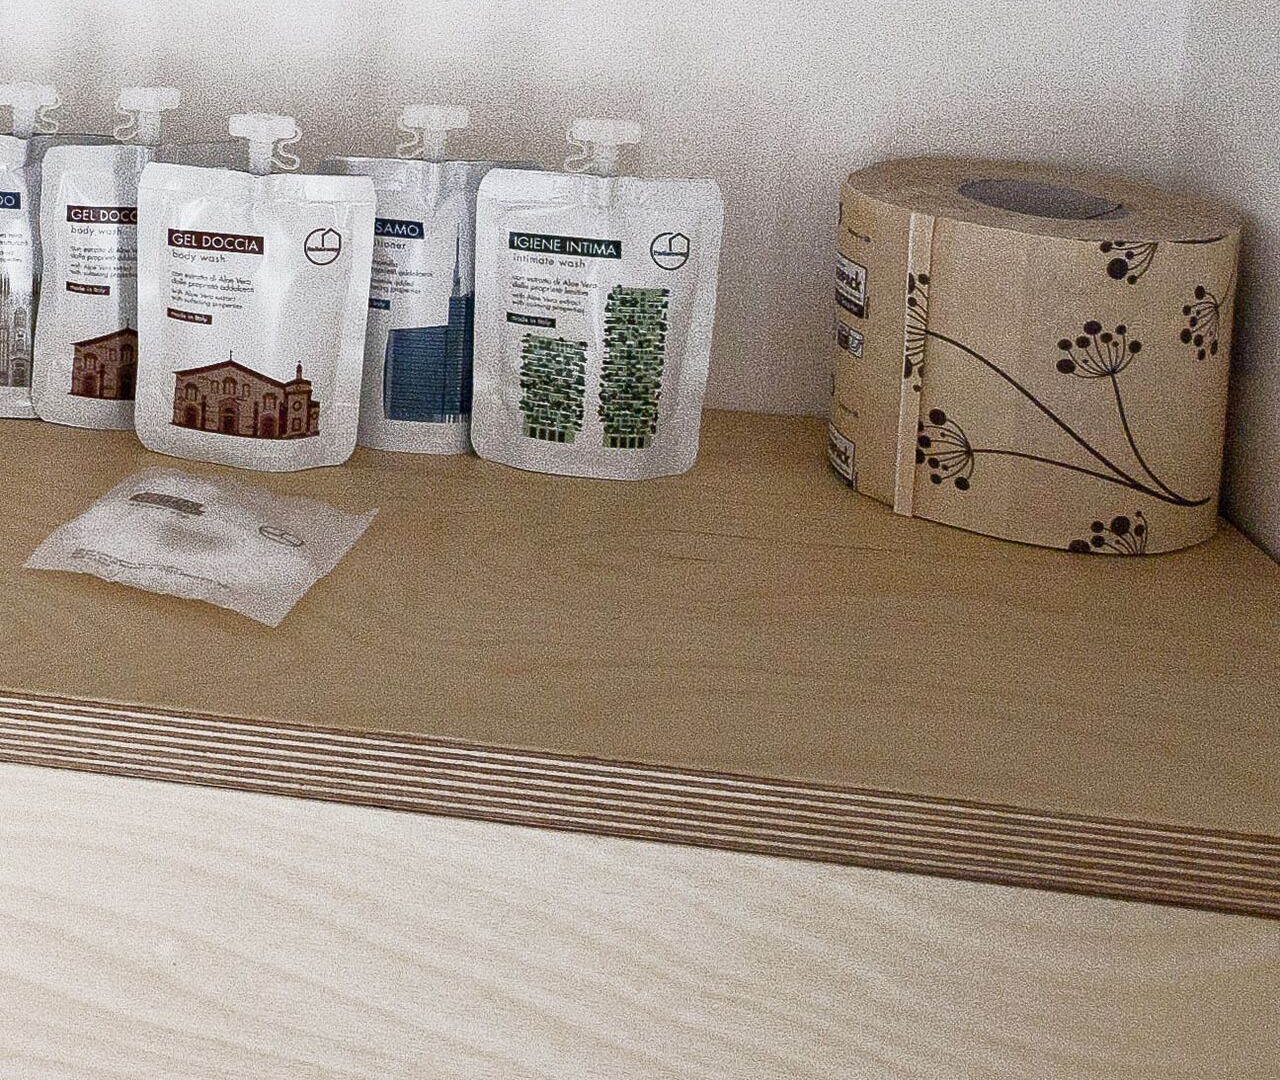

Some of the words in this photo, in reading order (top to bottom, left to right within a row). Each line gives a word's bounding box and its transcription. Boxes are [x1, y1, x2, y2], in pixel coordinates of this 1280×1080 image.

[71, 209, 97, 221] GEL
[70, 225, 95, 237] body
[172, 233, 197, 246] GEL
[202, 236, 259, 251] DOCCIA
[514, 236, 561, 251] IGIENE
[566, 239, 617, 256] INTIMA
[172, 249, 196, 262] body
[200, 254, 226, 263] wash
[513, 253, 555, 266] intimate
[559, 258, 586, 268] wash
